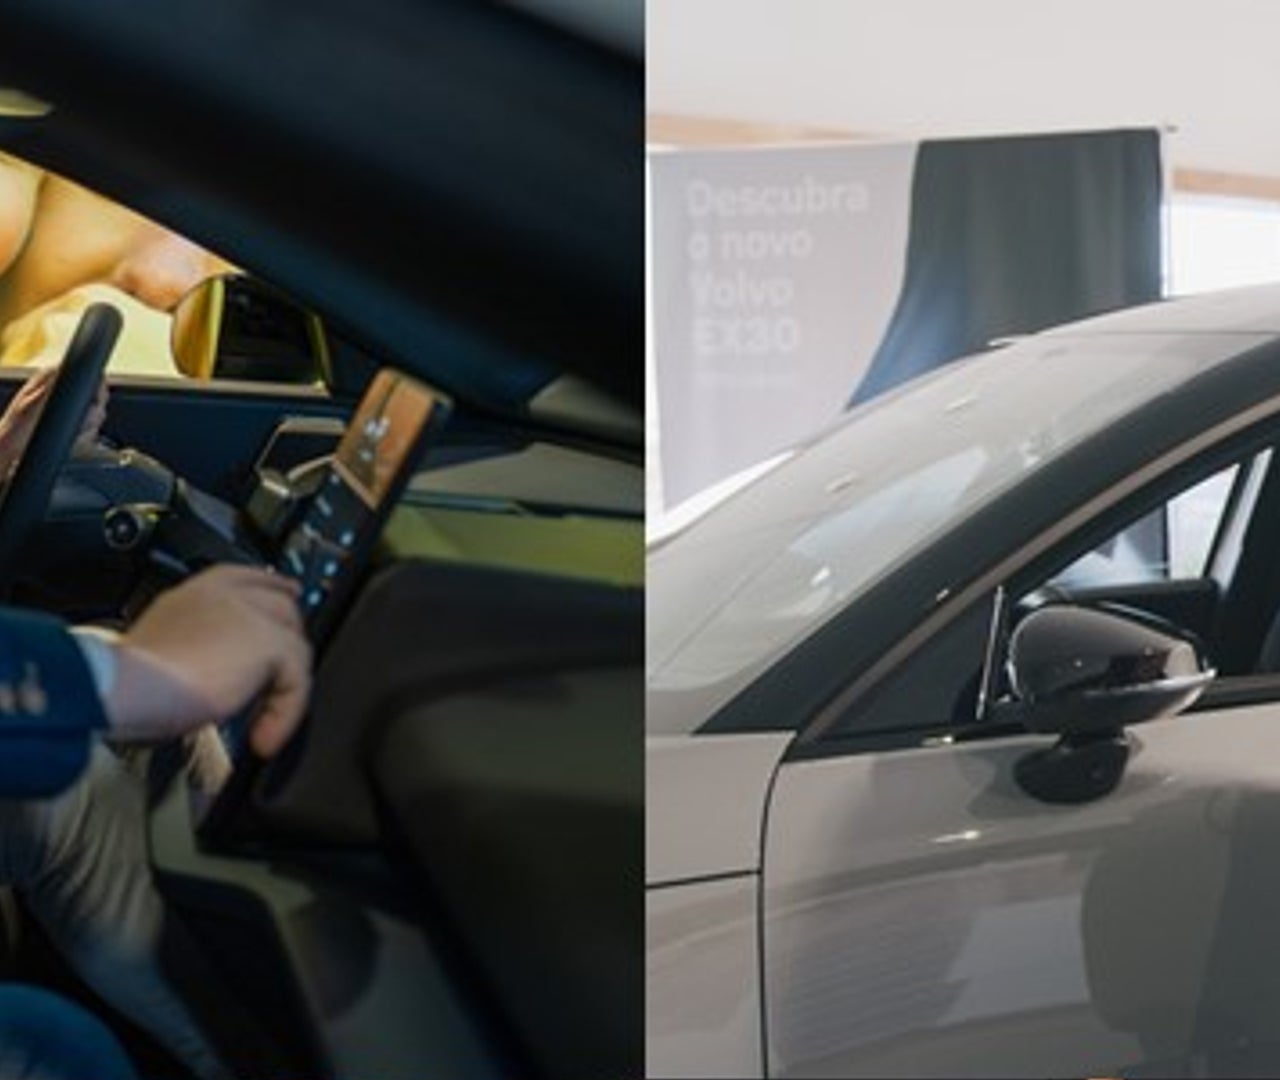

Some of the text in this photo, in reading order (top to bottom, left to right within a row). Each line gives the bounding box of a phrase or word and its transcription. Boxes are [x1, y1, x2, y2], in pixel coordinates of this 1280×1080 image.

[687, 228, 814, 261] o novo
[689, 269, 795, 307] Volvo
[692, 316, 802, 355] EX30
